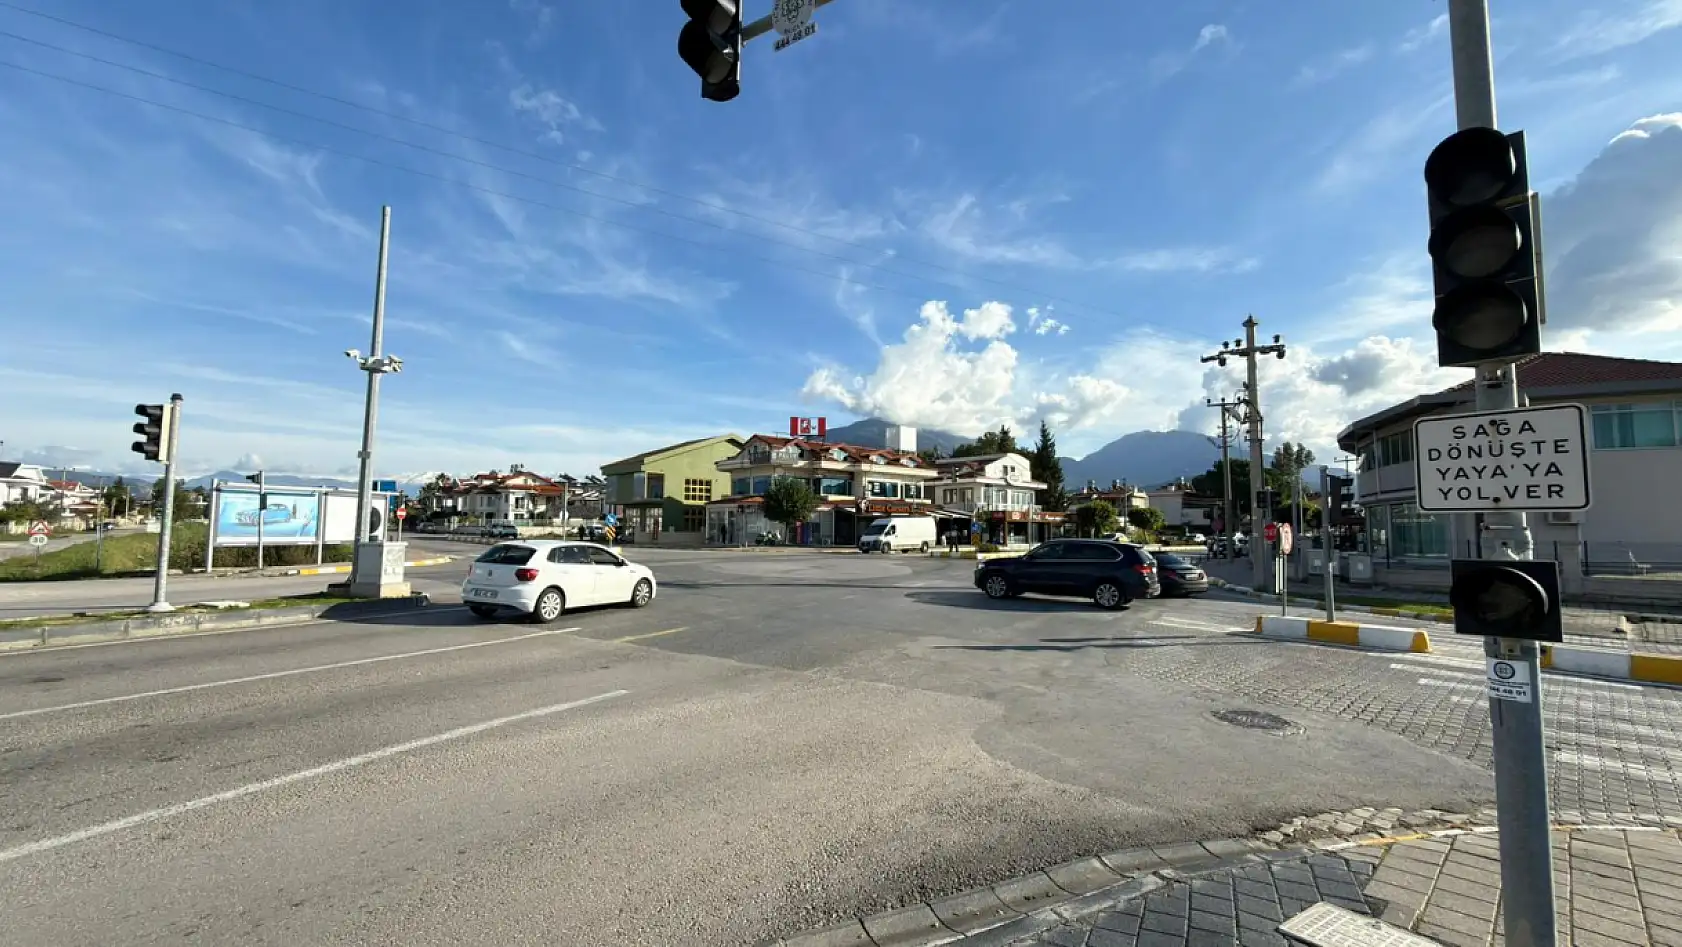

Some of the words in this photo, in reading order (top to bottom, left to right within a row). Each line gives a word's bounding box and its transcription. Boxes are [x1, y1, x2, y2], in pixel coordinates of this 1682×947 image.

[1452, 419, 1536, 440] SAĞA
[1428, 438, 1570, 462] DÖNÜŞTE
[1436, 461, 1563, 481] YAYA'YA
[1438, 486, 1490, 501] YOL
[1504, 484, 1565, 499] VER
